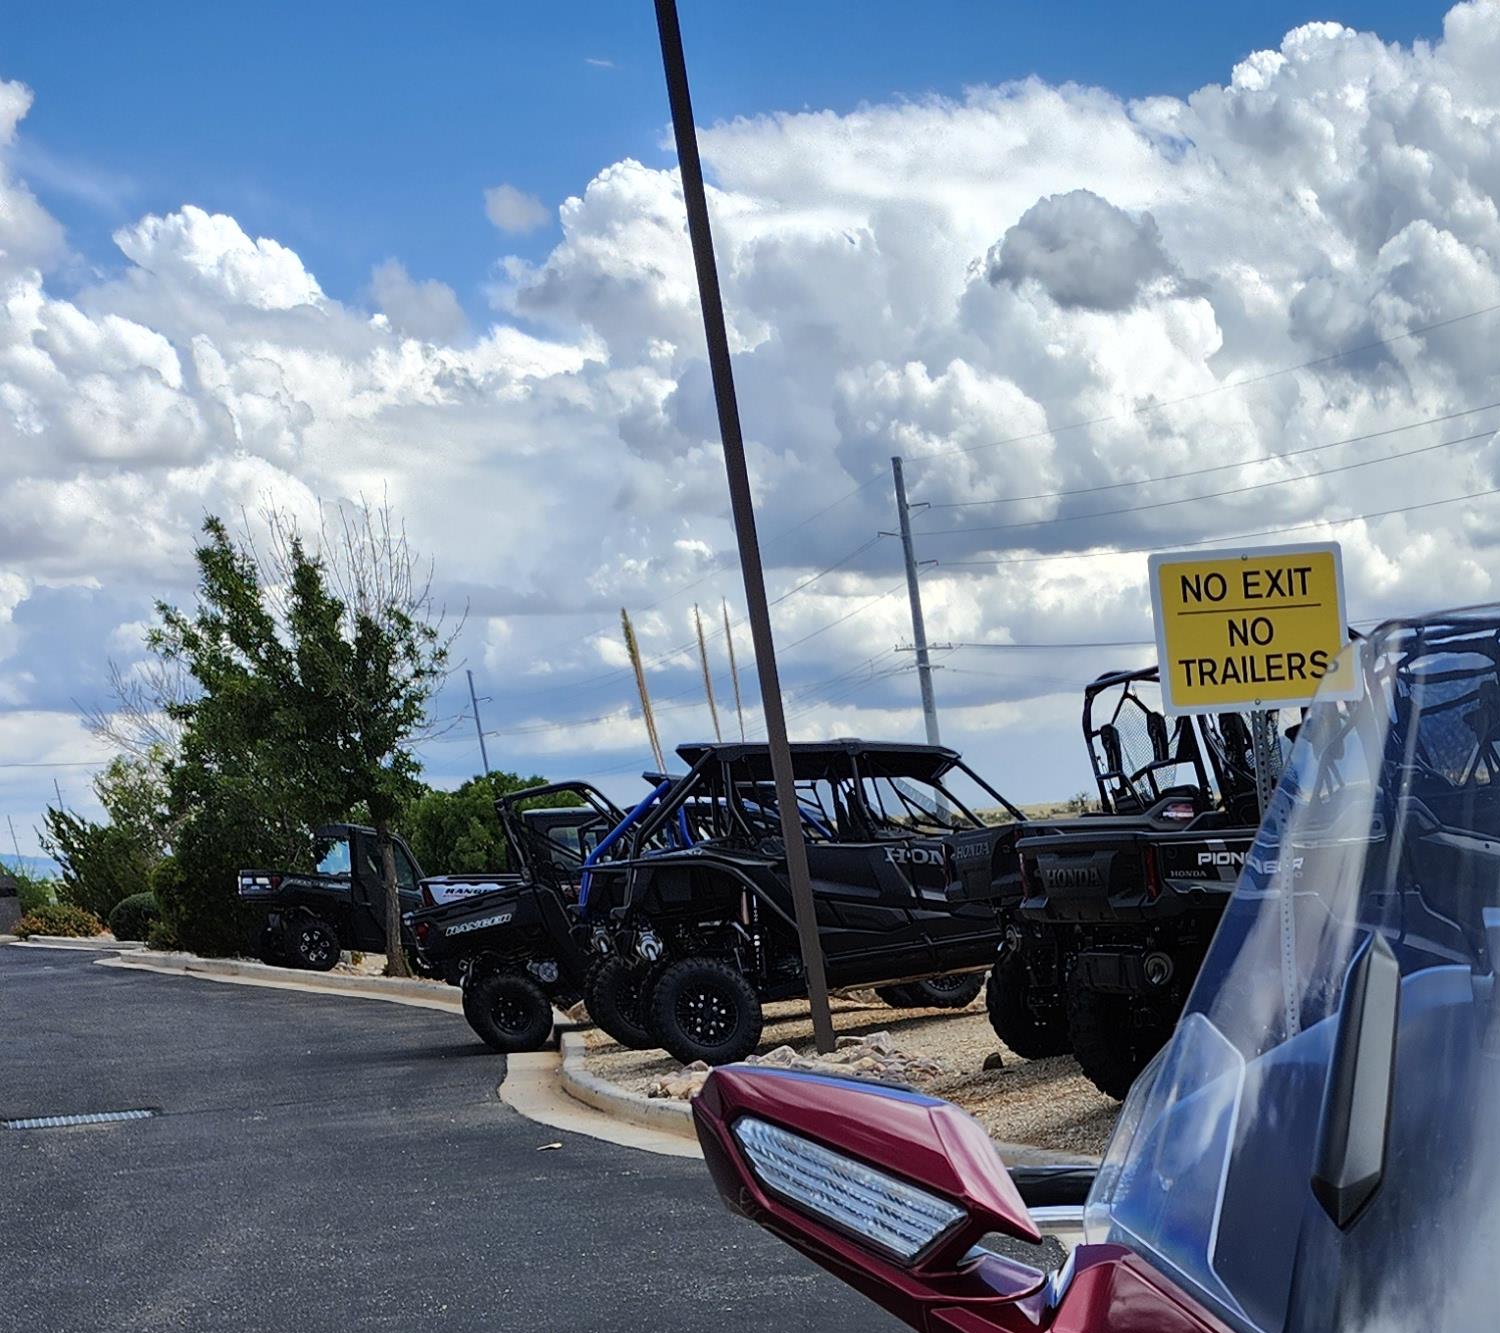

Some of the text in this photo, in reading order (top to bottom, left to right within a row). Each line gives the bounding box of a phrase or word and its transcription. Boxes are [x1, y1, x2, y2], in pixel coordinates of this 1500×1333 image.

[1181, 567, 1312, 603] NO EXIT
[1228, 617, 1274, 647] NO
[1178, 650, 1329, 687] TRAILERS
[884, 847, 944, 866] HON
[956, 842, 990, 860] HONDA
[1046, 867, 1104, 887] HONDA
[1170, 869, 1208, 879] HONDA
[445, 913, 513, 937] RANGER
